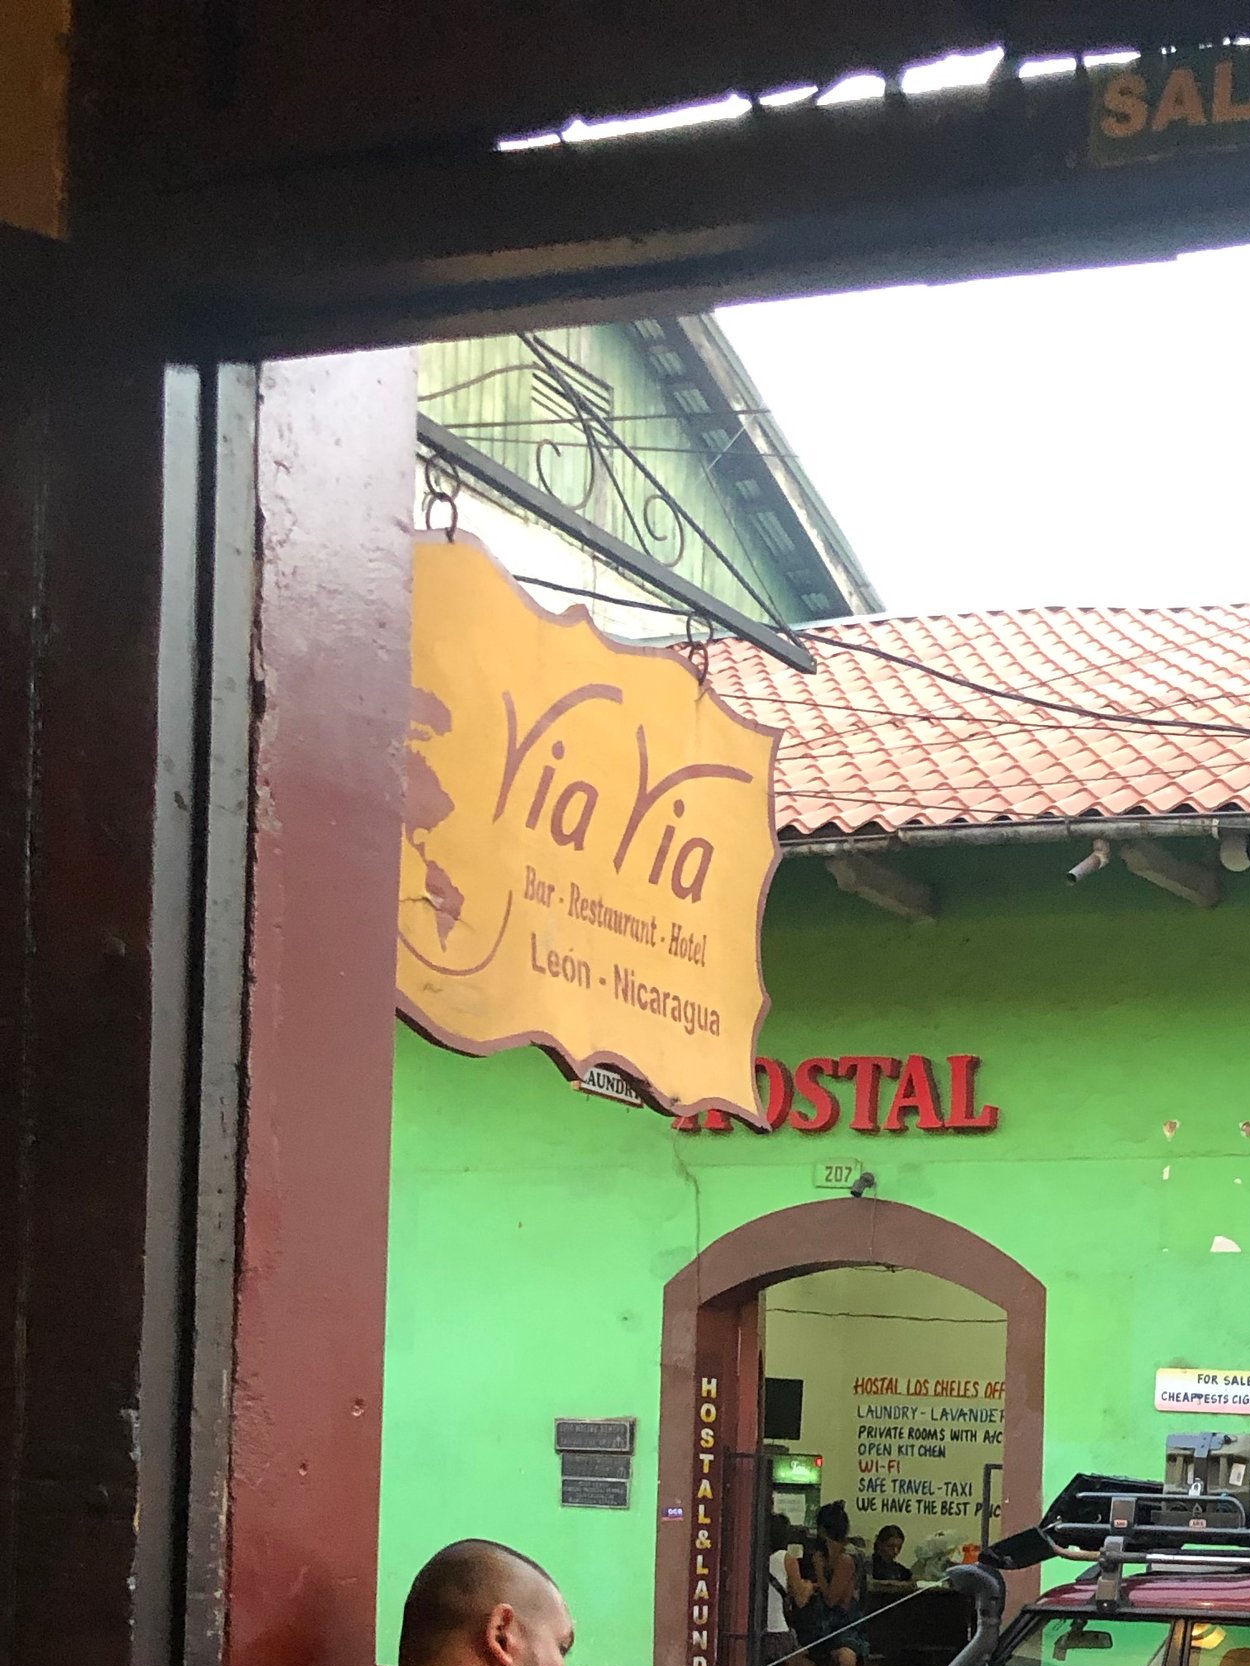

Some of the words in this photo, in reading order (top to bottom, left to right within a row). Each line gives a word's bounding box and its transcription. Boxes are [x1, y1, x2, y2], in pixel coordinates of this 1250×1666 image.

[492, 683, 623, 851] Via
[613, 724, 754, 903] Via
[524, 865, 556, 908] Bar
[568, 882, 657, 948] Restaurant
[668, 922, 707, 967] Hotel
[530, 932, 591, 989] León
[613, 963, 720, 1037] Nicaragua
[584, 1070, 639, 1100] AUNDR
[825, 1166, 853, 1183] 207
[853, 1377, 902, 1396] HOSTAL
[906, 1378, 930, 1396] LOS
[934, 1379, 980, 1398] CHELES
[1197, 1374, 1218, 1385] FOR
[857, 1405, 919, 1420] LAUNDRY
[858, 1425, 904, 1440] PRIVATE
[907, 1427, 946, 1442] ROOMS
[950, 1429, 977, 1443] WITH
[858, 1443, 892, 1456] OPEN
[858, 1460, 901, 1474] WI-FI
[858, 1477, 887, 1493] SAFE
[856, 1497, 877, 1512] WE
[881, 1498, 912, 1514] HAVE
[916, 1499, 937, 1515] THE
[941, 1502, 970, 1517] BEST
[974, 1503, 1001, 1518] PIC
